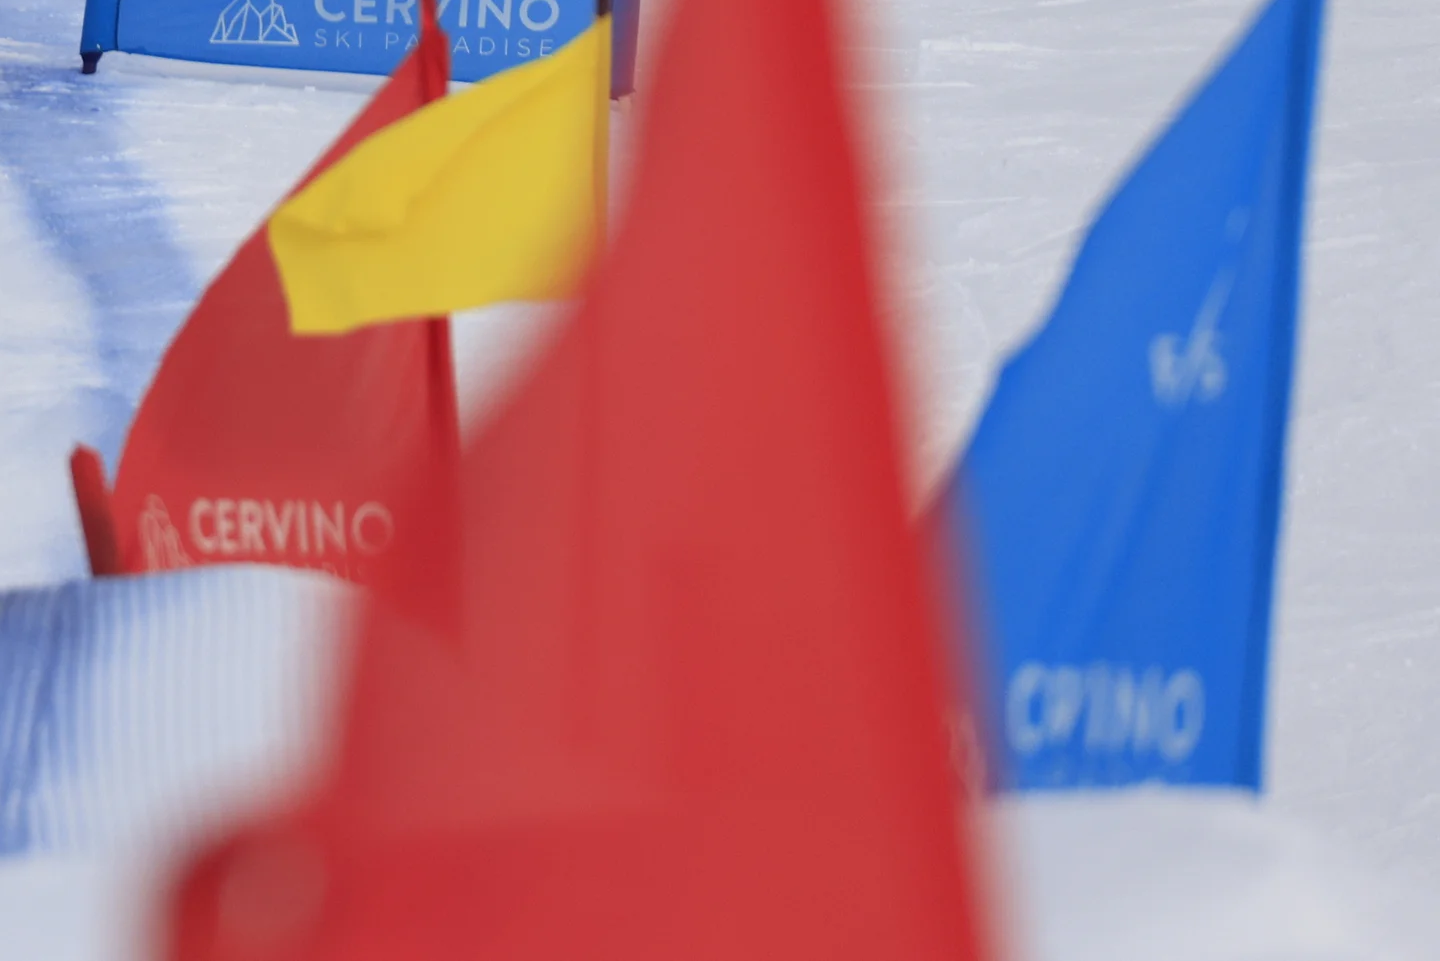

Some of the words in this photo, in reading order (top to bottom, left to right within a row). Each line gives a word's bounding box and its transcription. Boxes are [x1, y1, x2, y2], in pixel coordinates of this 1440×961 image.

[314, 28, 363, 49] SKI
[385, 31, 554, 58] PAADISE
[188, 497, 395, 556] CERVINO
